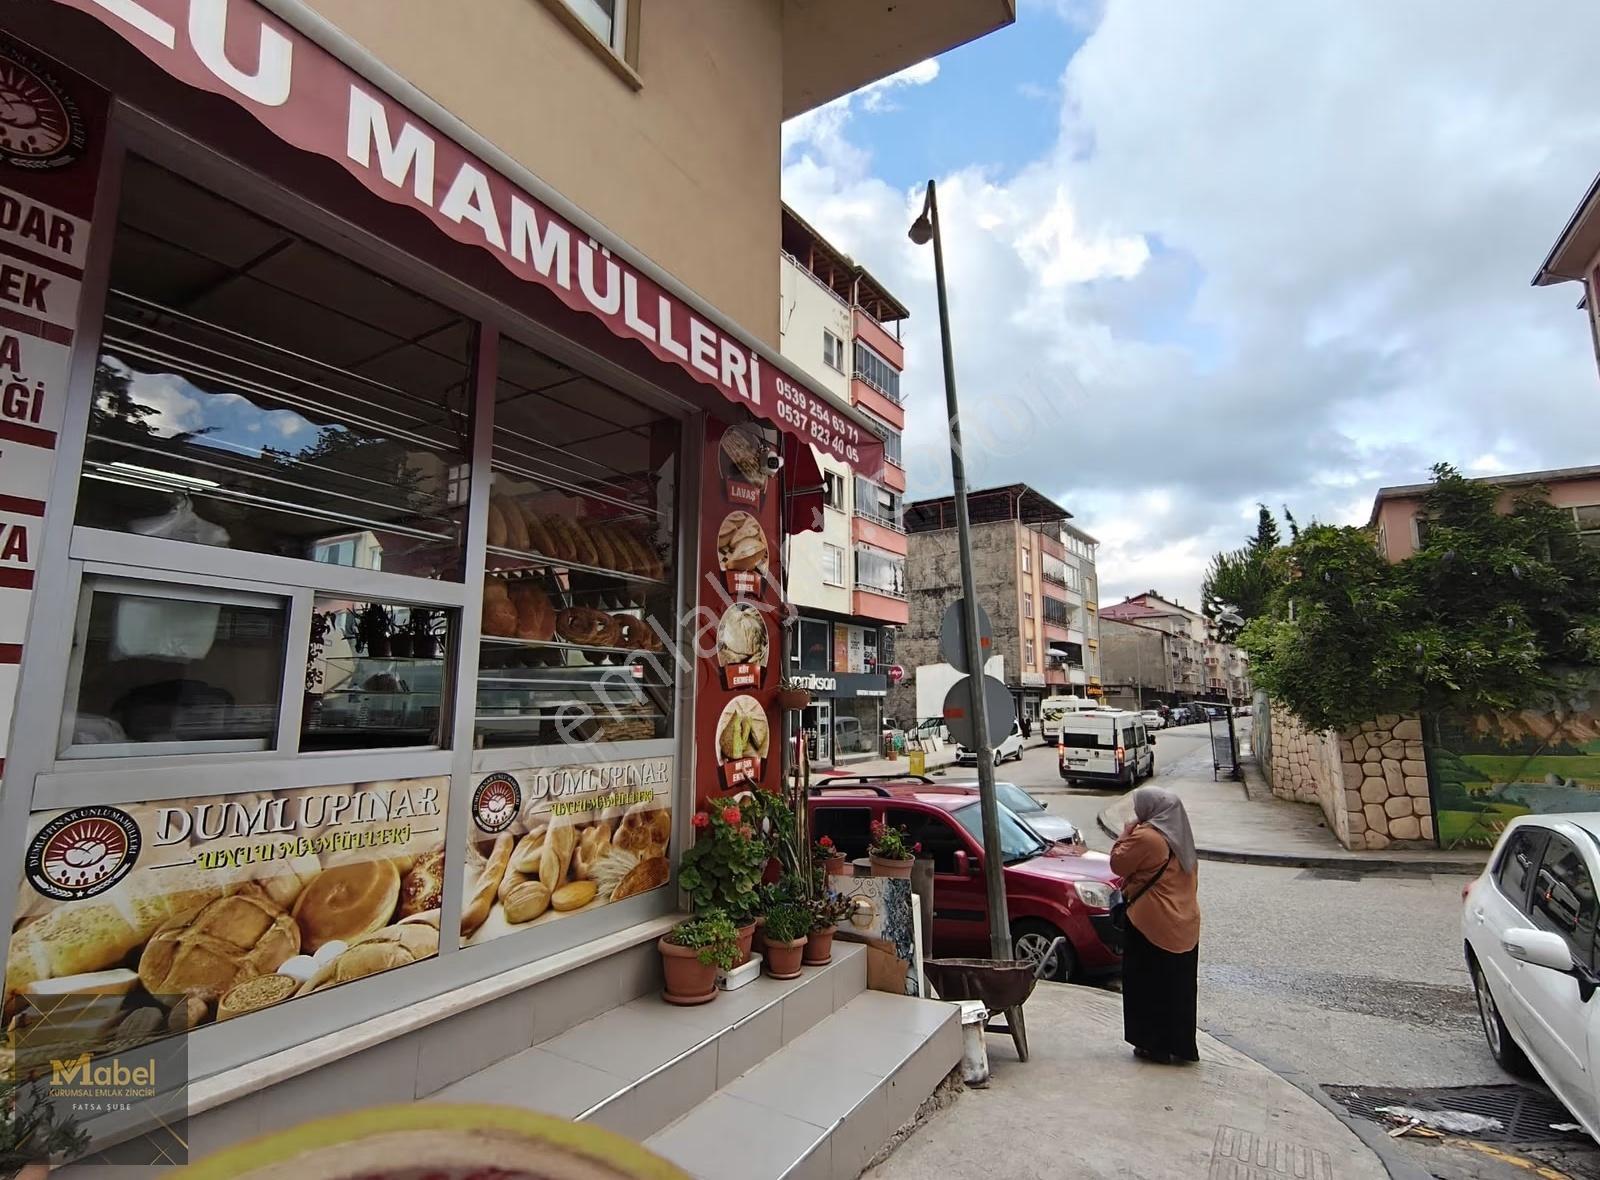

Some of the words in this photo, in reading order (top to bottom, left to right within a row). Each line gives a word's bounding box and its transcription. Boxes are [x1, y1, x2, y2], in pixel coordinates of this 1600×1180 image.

[346, 83, 761, 406] MAMÜLLERİ
[0, 374, 45, 424] Ğİ
[776, 377, 806, 409] 0539
[809, 400, 830, 425] 254
[832, 415, 845, 435] 63
[846, 425, 858, 444] 71
[777, 400, 808, 430] 0537
[811, 420, 830, 445] 823
[832, 435, 844, 454] 40
[846, 445, 859, 463] 05
[531, 760, 669, 800] DUMLUPINAR
[153, 786, 440, 847] DUMLUPINAR
